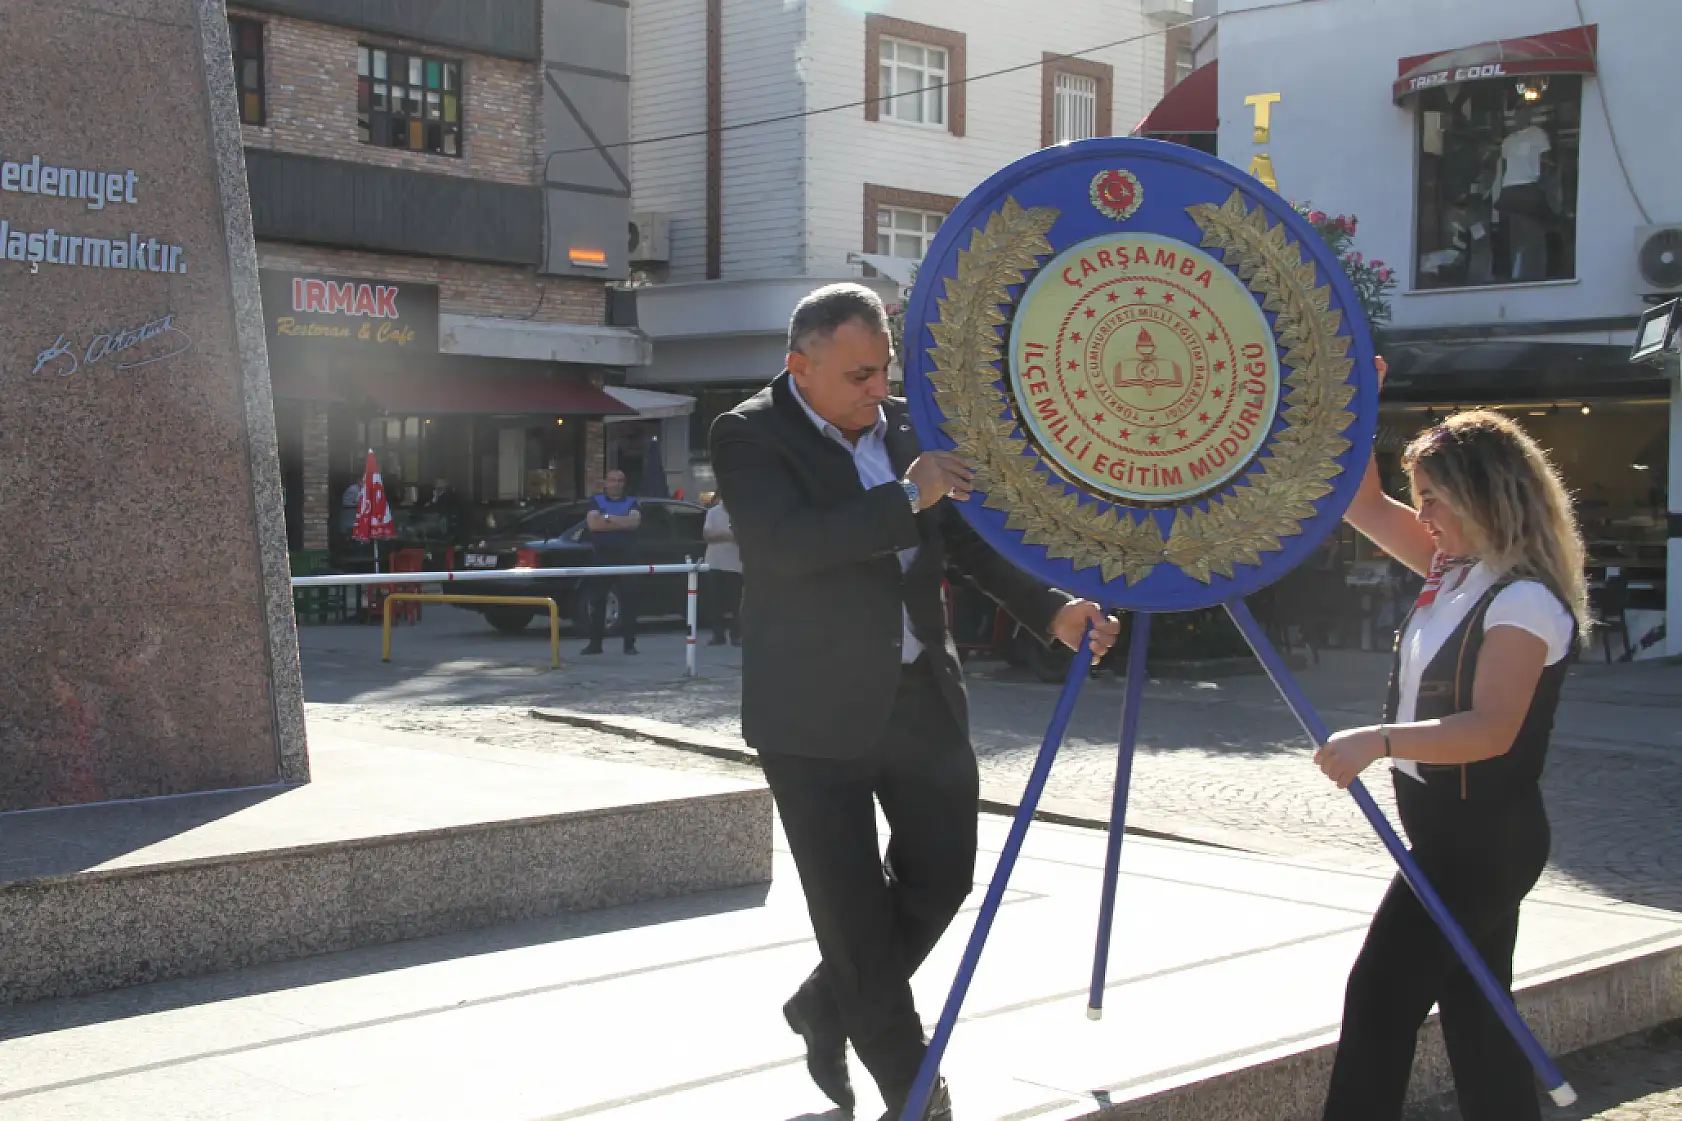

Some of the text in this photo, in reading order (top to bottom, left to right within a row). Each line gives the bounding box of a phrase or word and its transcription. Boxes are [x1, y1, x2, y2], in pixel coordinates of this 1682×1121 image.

[1454, 63, 1506, 81] COOL
[1062, 246, 1213, 289] ÇARŞAMBA
[292, 277, 399, 320] IRMAK
[357, 321, 371, 340] &
[1021, 342, 1266, 488] İLÇE MİLLİ EĞİTİM MÜDÜRLÜĞÜ
